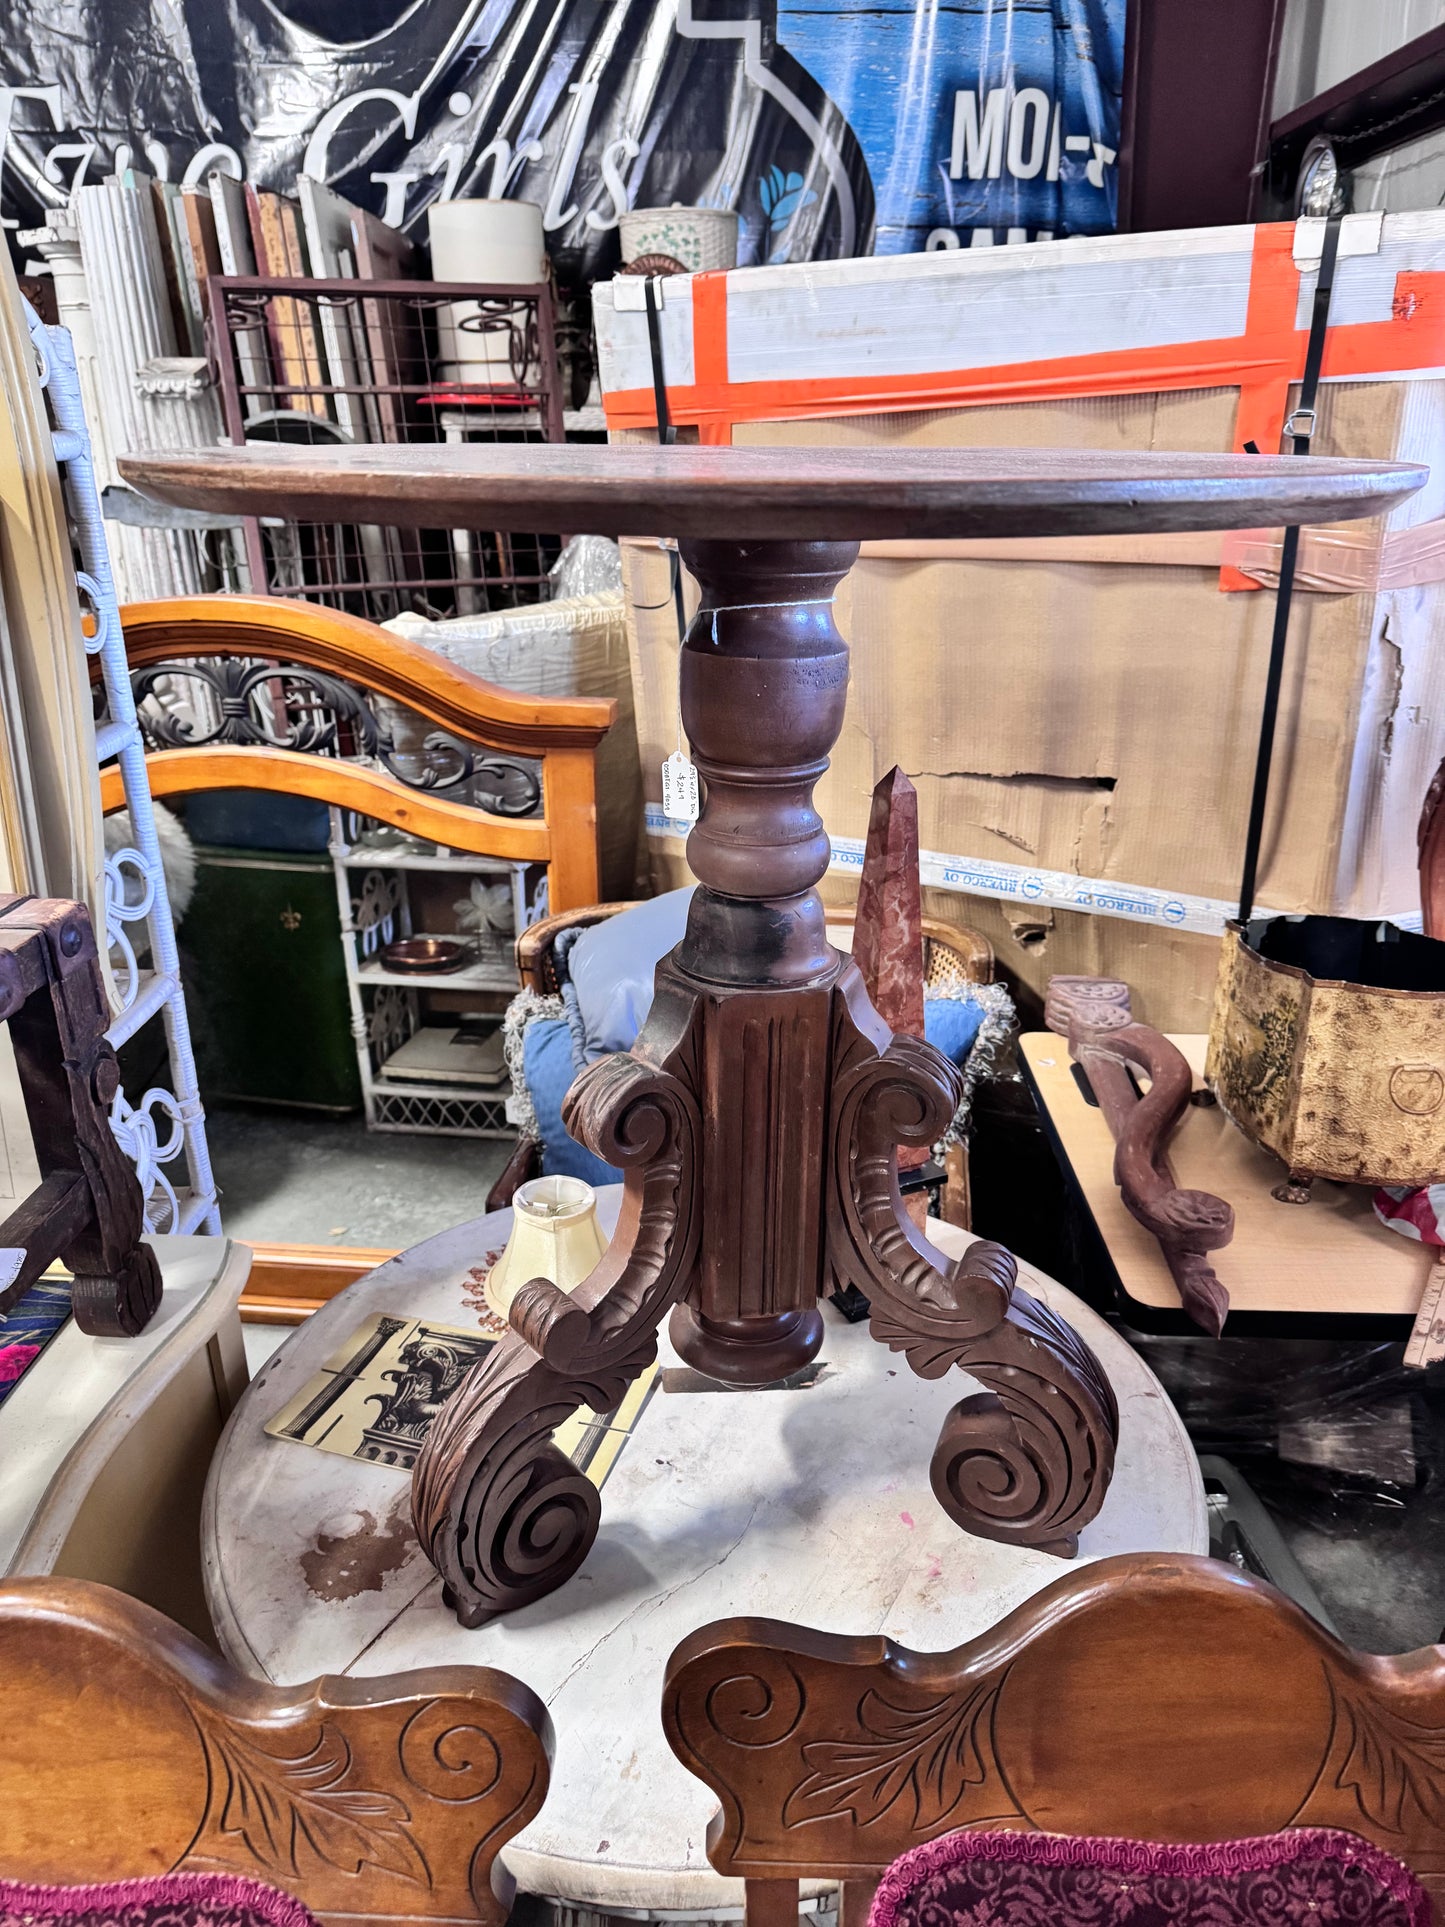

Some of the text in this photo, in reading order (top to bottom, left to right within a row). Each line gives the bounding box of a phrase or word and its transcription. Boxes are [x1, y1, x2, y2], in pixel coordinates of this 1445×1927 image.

[303, 82, 641, 230] Girls
[943, 871, 1018, 893] RIVERCO OY
[1075, 894, 1157, 917] RIVERCO OY
